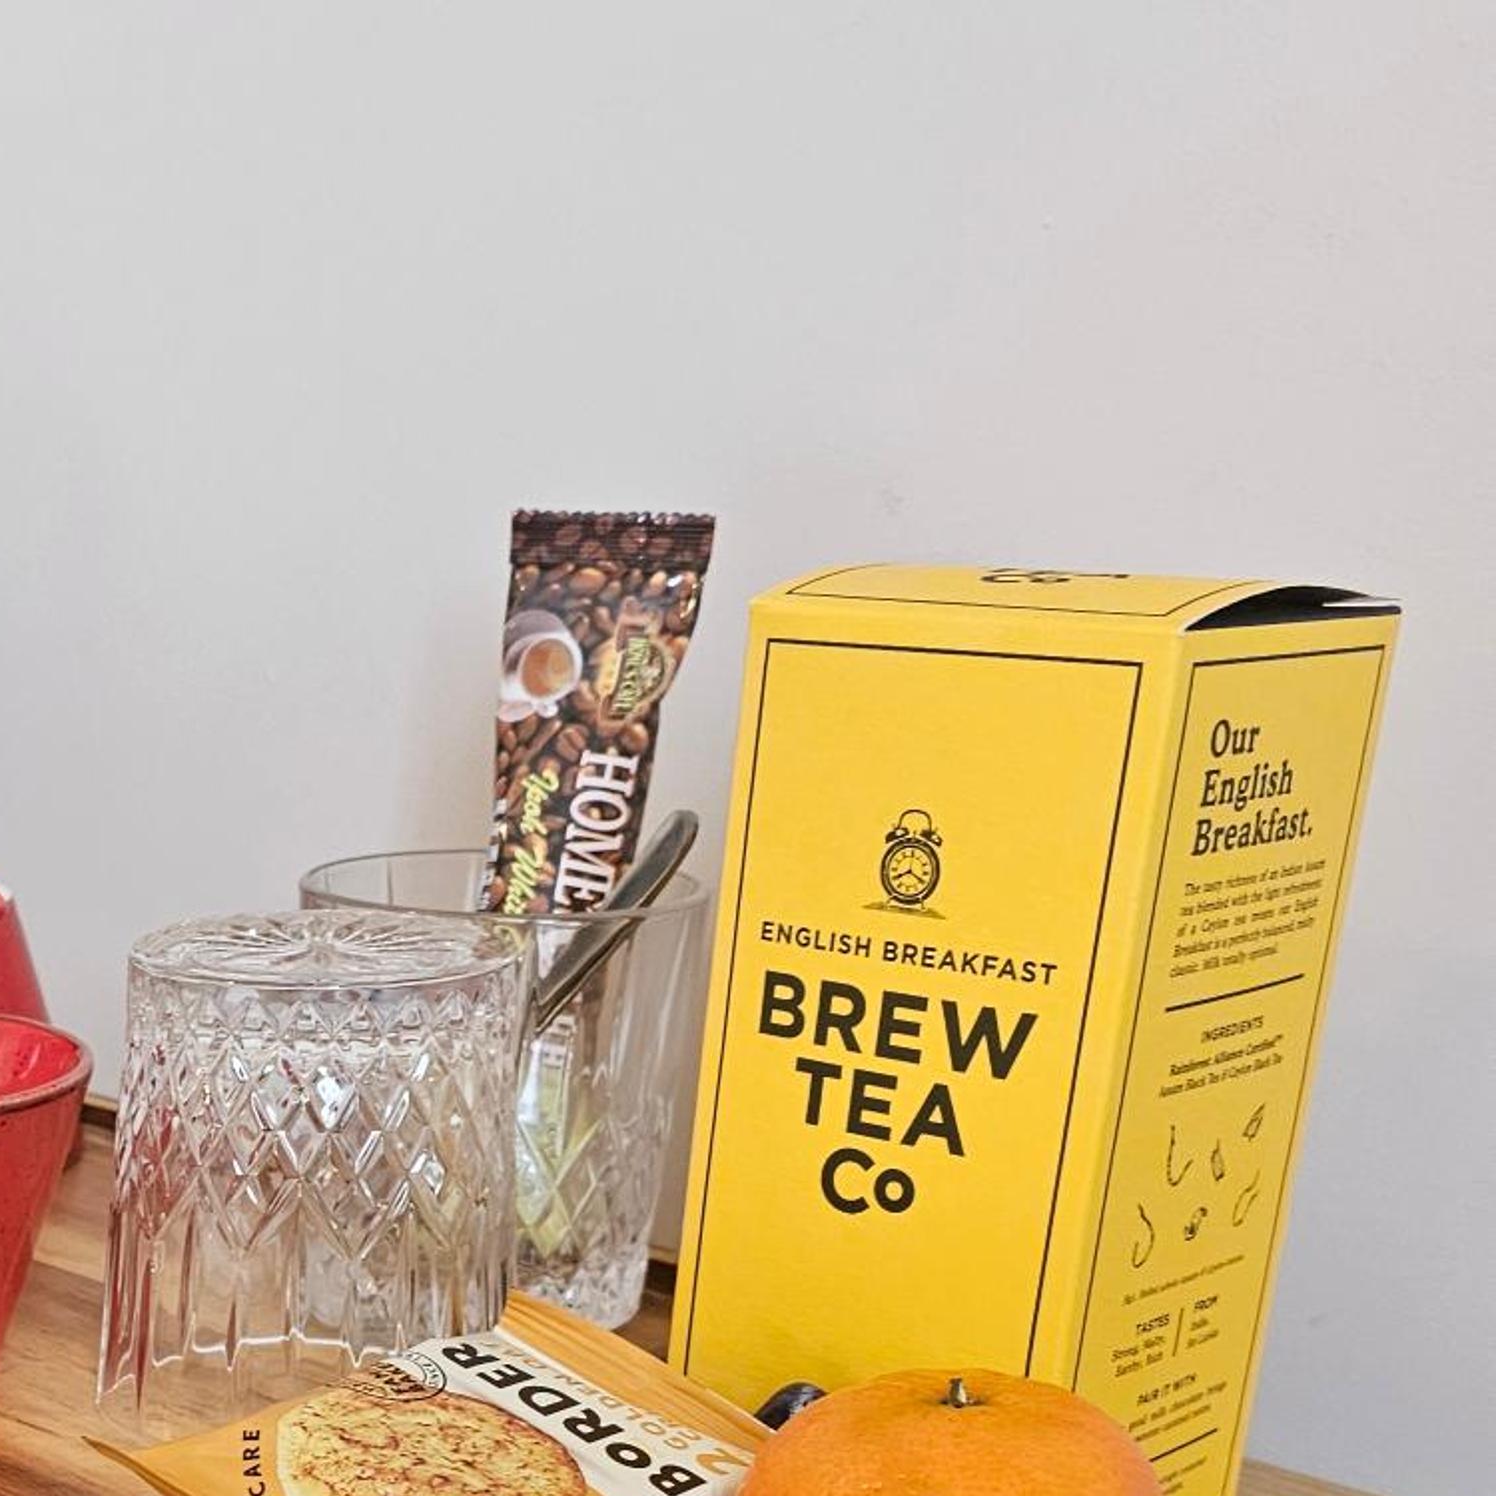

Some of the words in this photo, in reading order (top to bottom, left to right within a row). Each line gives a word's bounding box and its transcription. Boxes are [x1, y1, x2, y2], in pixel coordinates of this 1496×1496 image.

[1210, 718, 1260, 758] Our
[1199, 759, 1294, 812] English
[554, 749, 640, 913] HOME
[1190, 806, 1313, 857] Breakfast.
[761, 920, 872, 957] ENGLISH
[883, 941, 1058, 986] BREAKFAST
[759, 969, 1039, 1081] BREW
[1201, 1014, 1264, 1043] INGREDIENTS
[795, 1056, 966, 1158] TEA
[821, 1147, 916, 1215] Co
[1136, 1313, 1171, 1335] TASTES
